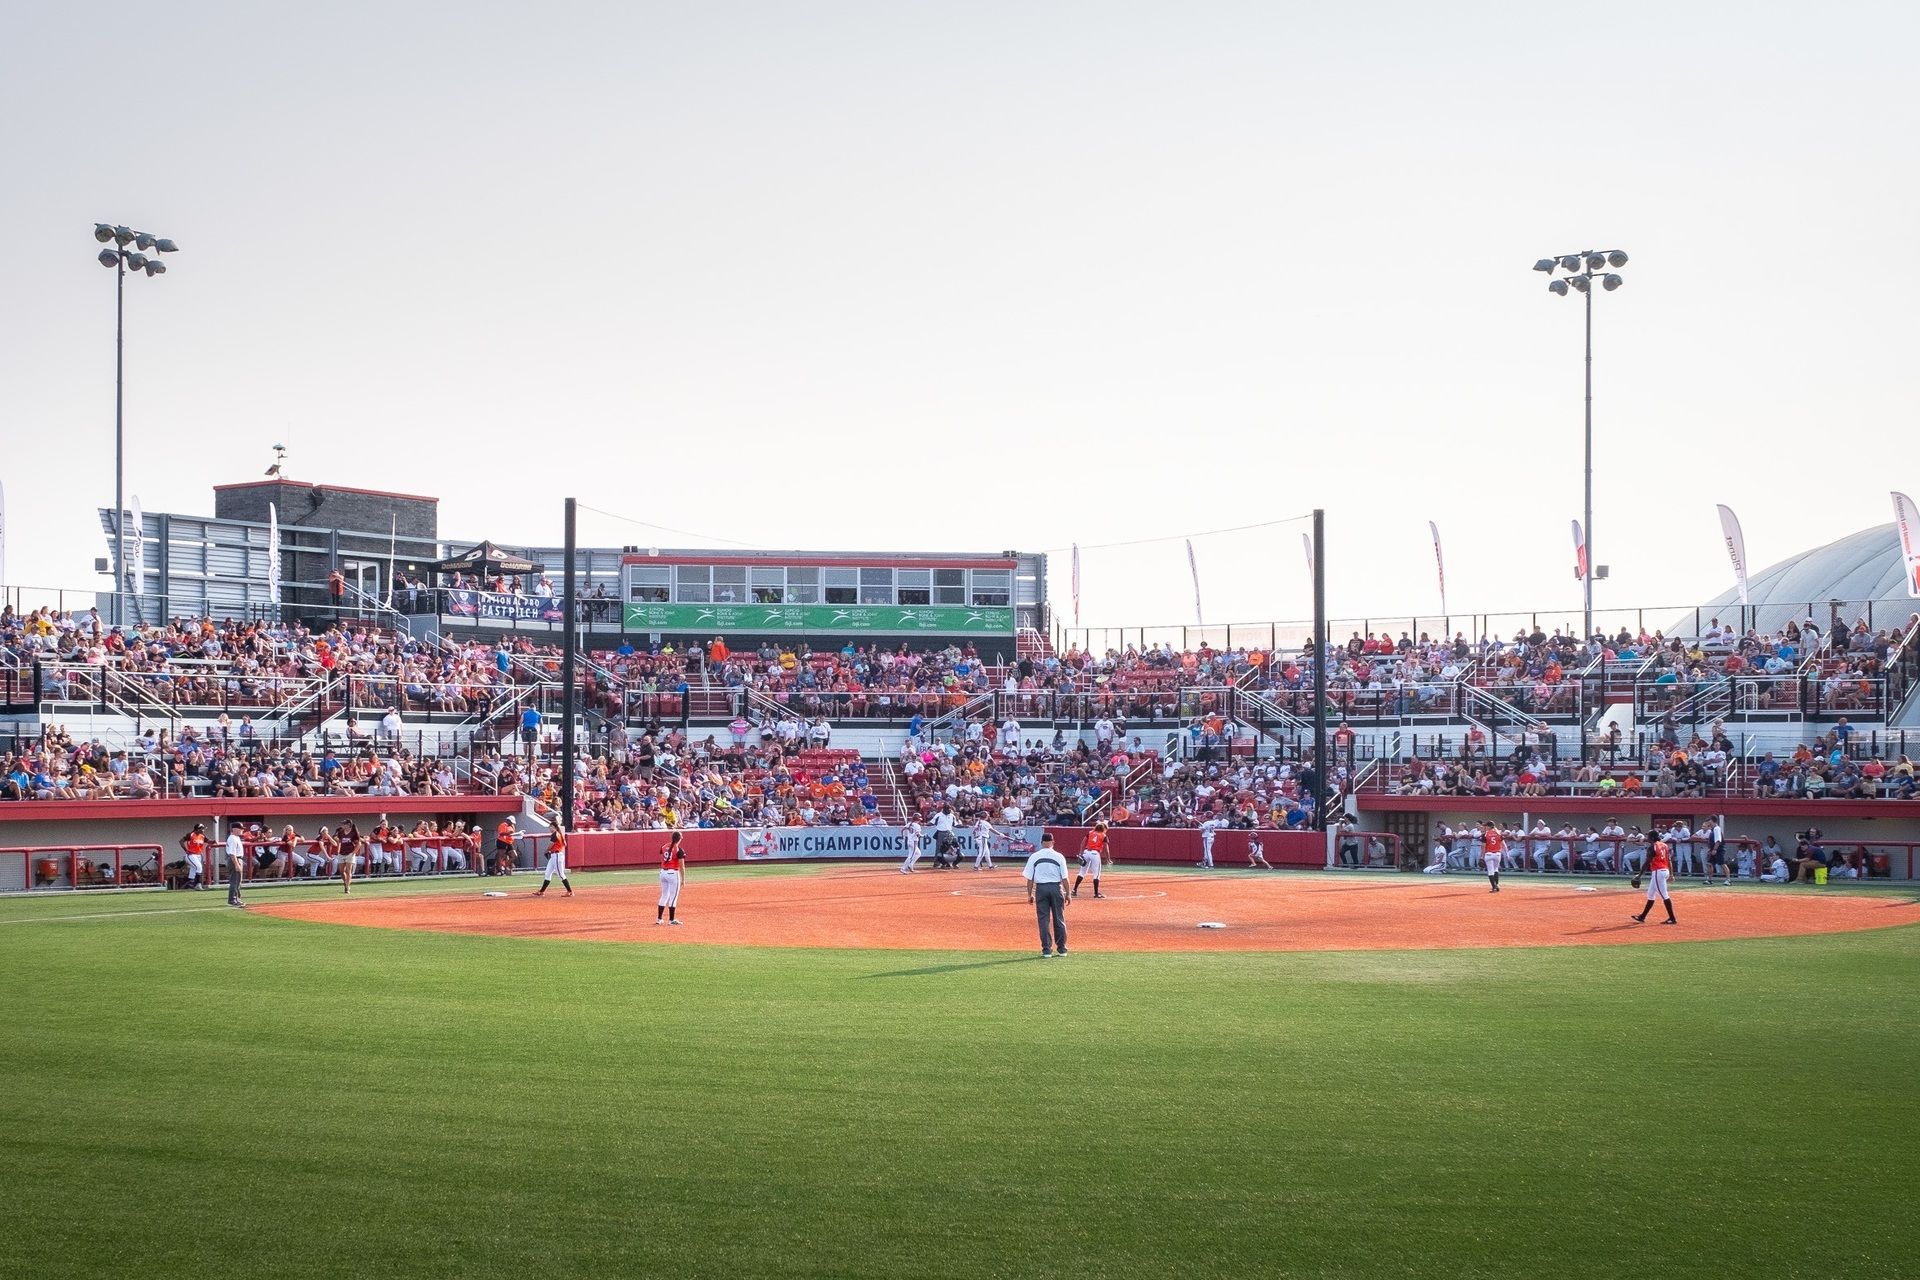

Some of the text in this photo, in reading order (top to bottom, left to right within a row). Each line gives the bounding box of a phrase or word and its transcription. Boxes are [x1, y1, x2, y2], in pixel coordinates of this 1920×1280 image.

[482, 604, 538, 619] FASTPITCH
[780, 837, 799, 851] NPF
[1491, 836, 1497, 845] 5
